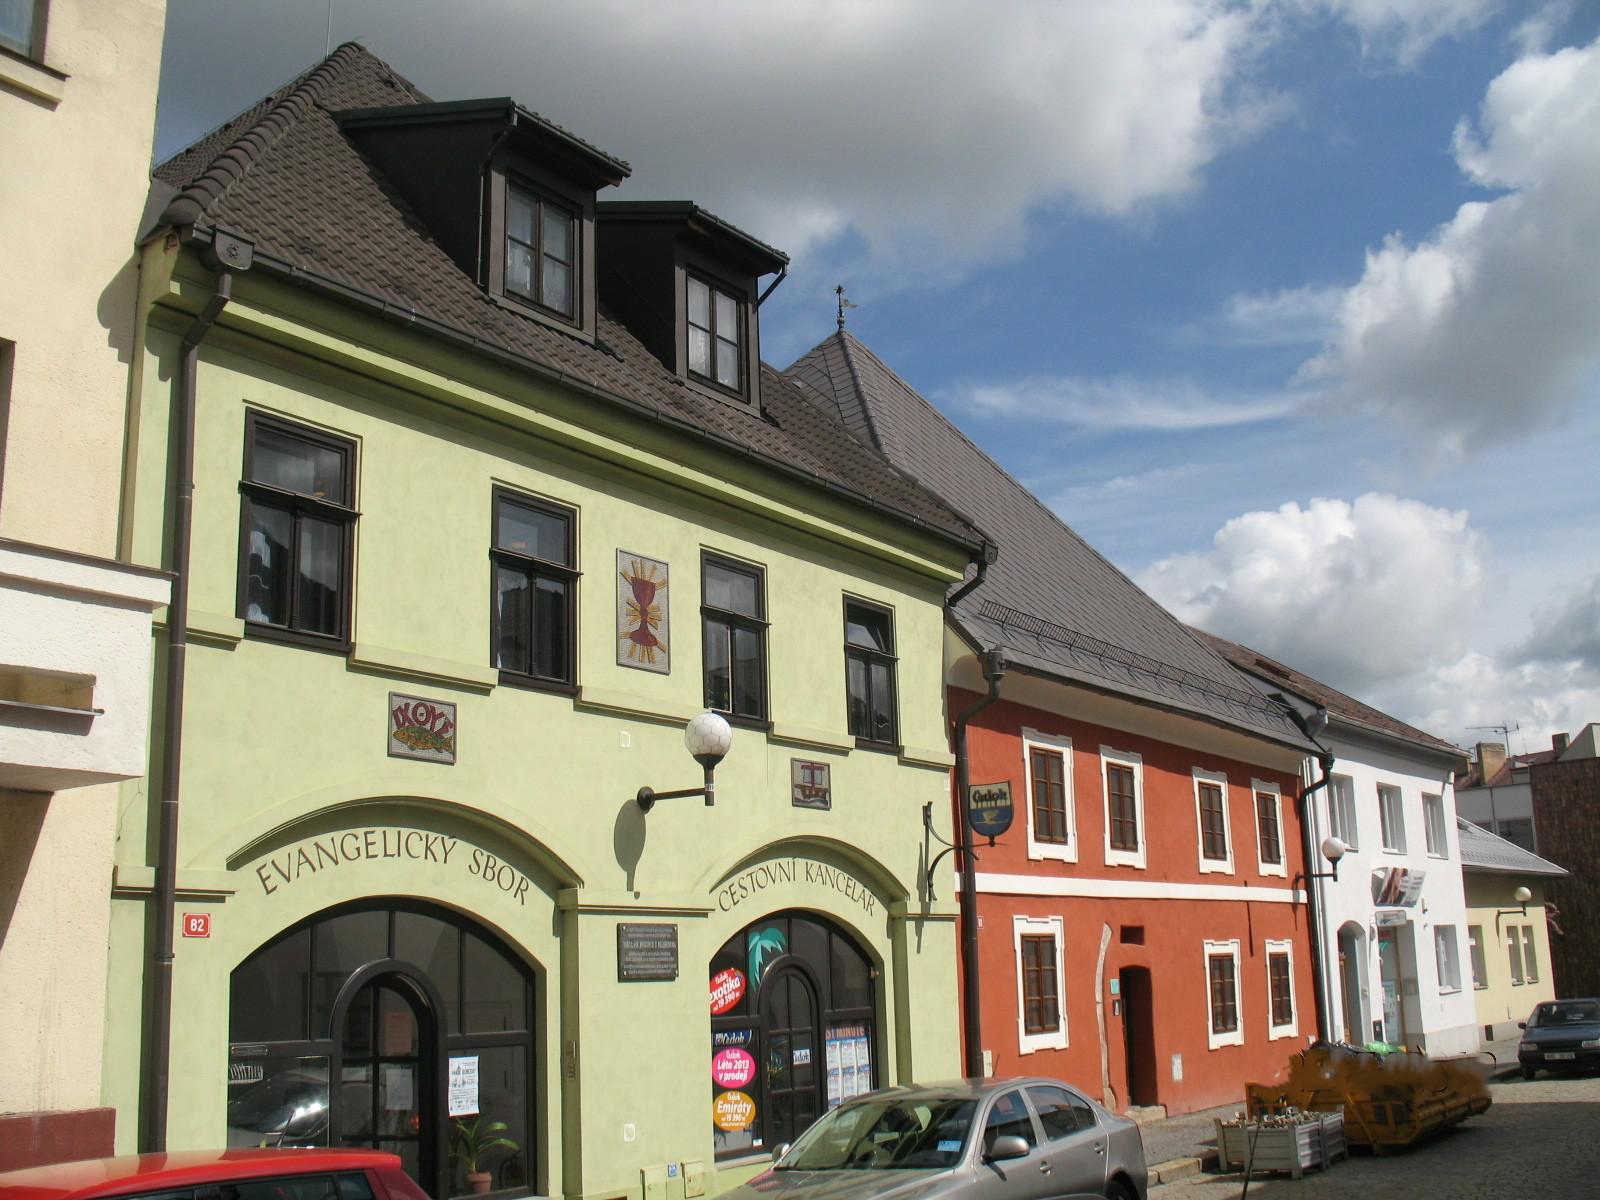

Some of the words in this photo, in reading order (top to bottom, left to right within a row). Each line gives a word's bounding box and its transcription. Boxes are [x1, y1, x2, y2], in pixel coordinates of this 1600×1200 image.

[255, 830, 456, 895] EVANGELICKÝ
[468, 848, 529, 905] SBOR
[718, 856, 796, 912] CESTOVNÍ
[190, 918, 204, 931] 82
[717, 1059, 733, 1070] Léto
[733, 1059, 750, 1070] 2013
[718, 1072, 723, 1080] v
[717, 1100, 752, 1116] Emiráty
